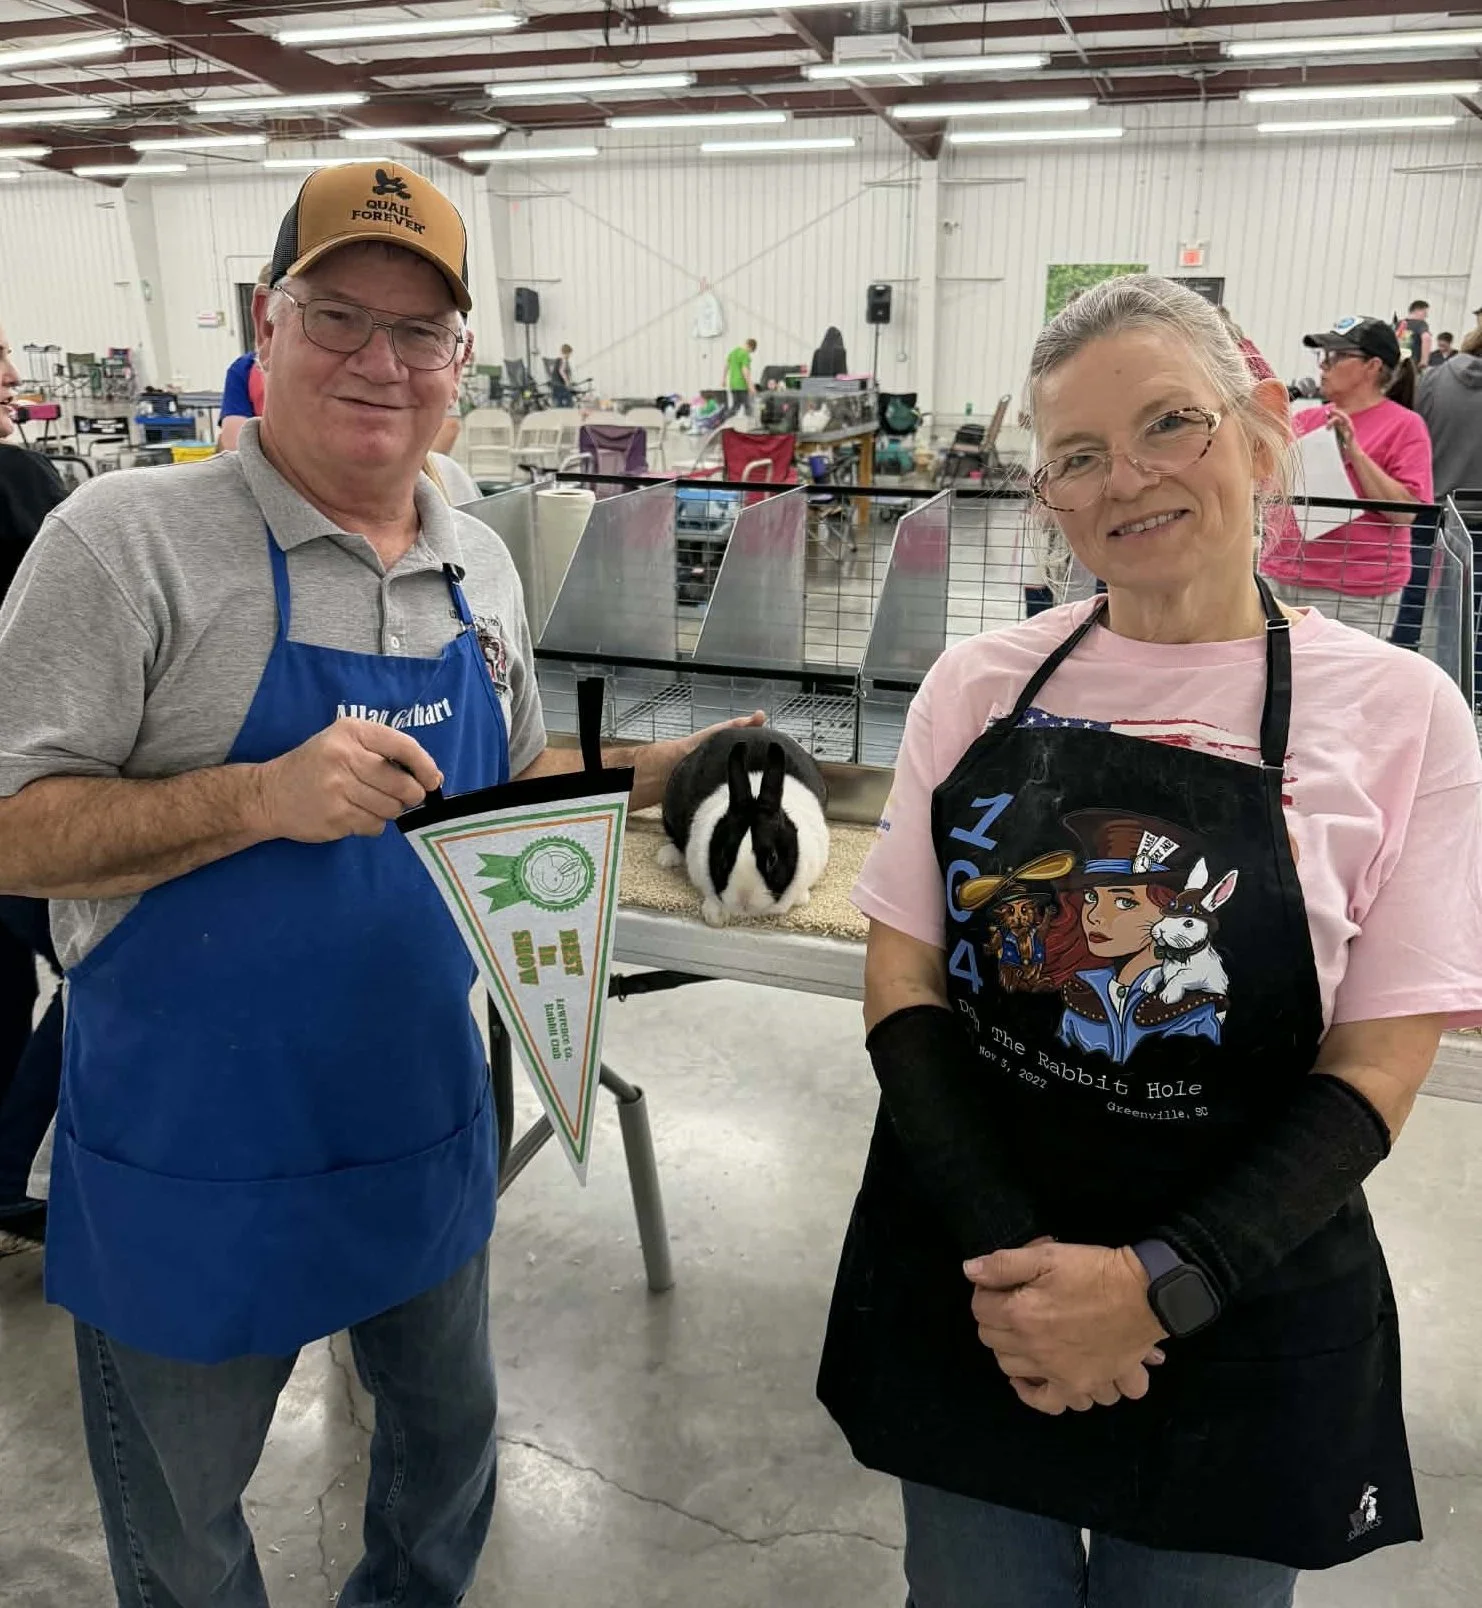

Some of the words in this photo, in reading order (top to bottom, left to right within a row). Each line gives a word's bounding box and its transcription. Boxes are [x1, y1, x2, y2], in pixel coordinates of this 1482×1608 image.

[351, 209, 425, 234] FOREVER
[366, 200, 411, 217] QUAIL
[511, 929, 539, 986] SHOW
[979, 1044, 997, 1061] Nov
[1019, 1068, 1048, 1089] 2022
[991, 1026, 1026, 1055] The
[1038, 1050, 1128, 1095] Rabbit
[1146, 1080, 1202, 1099] Hole
[1106, 1101, 1190, 1119] Greenville,
